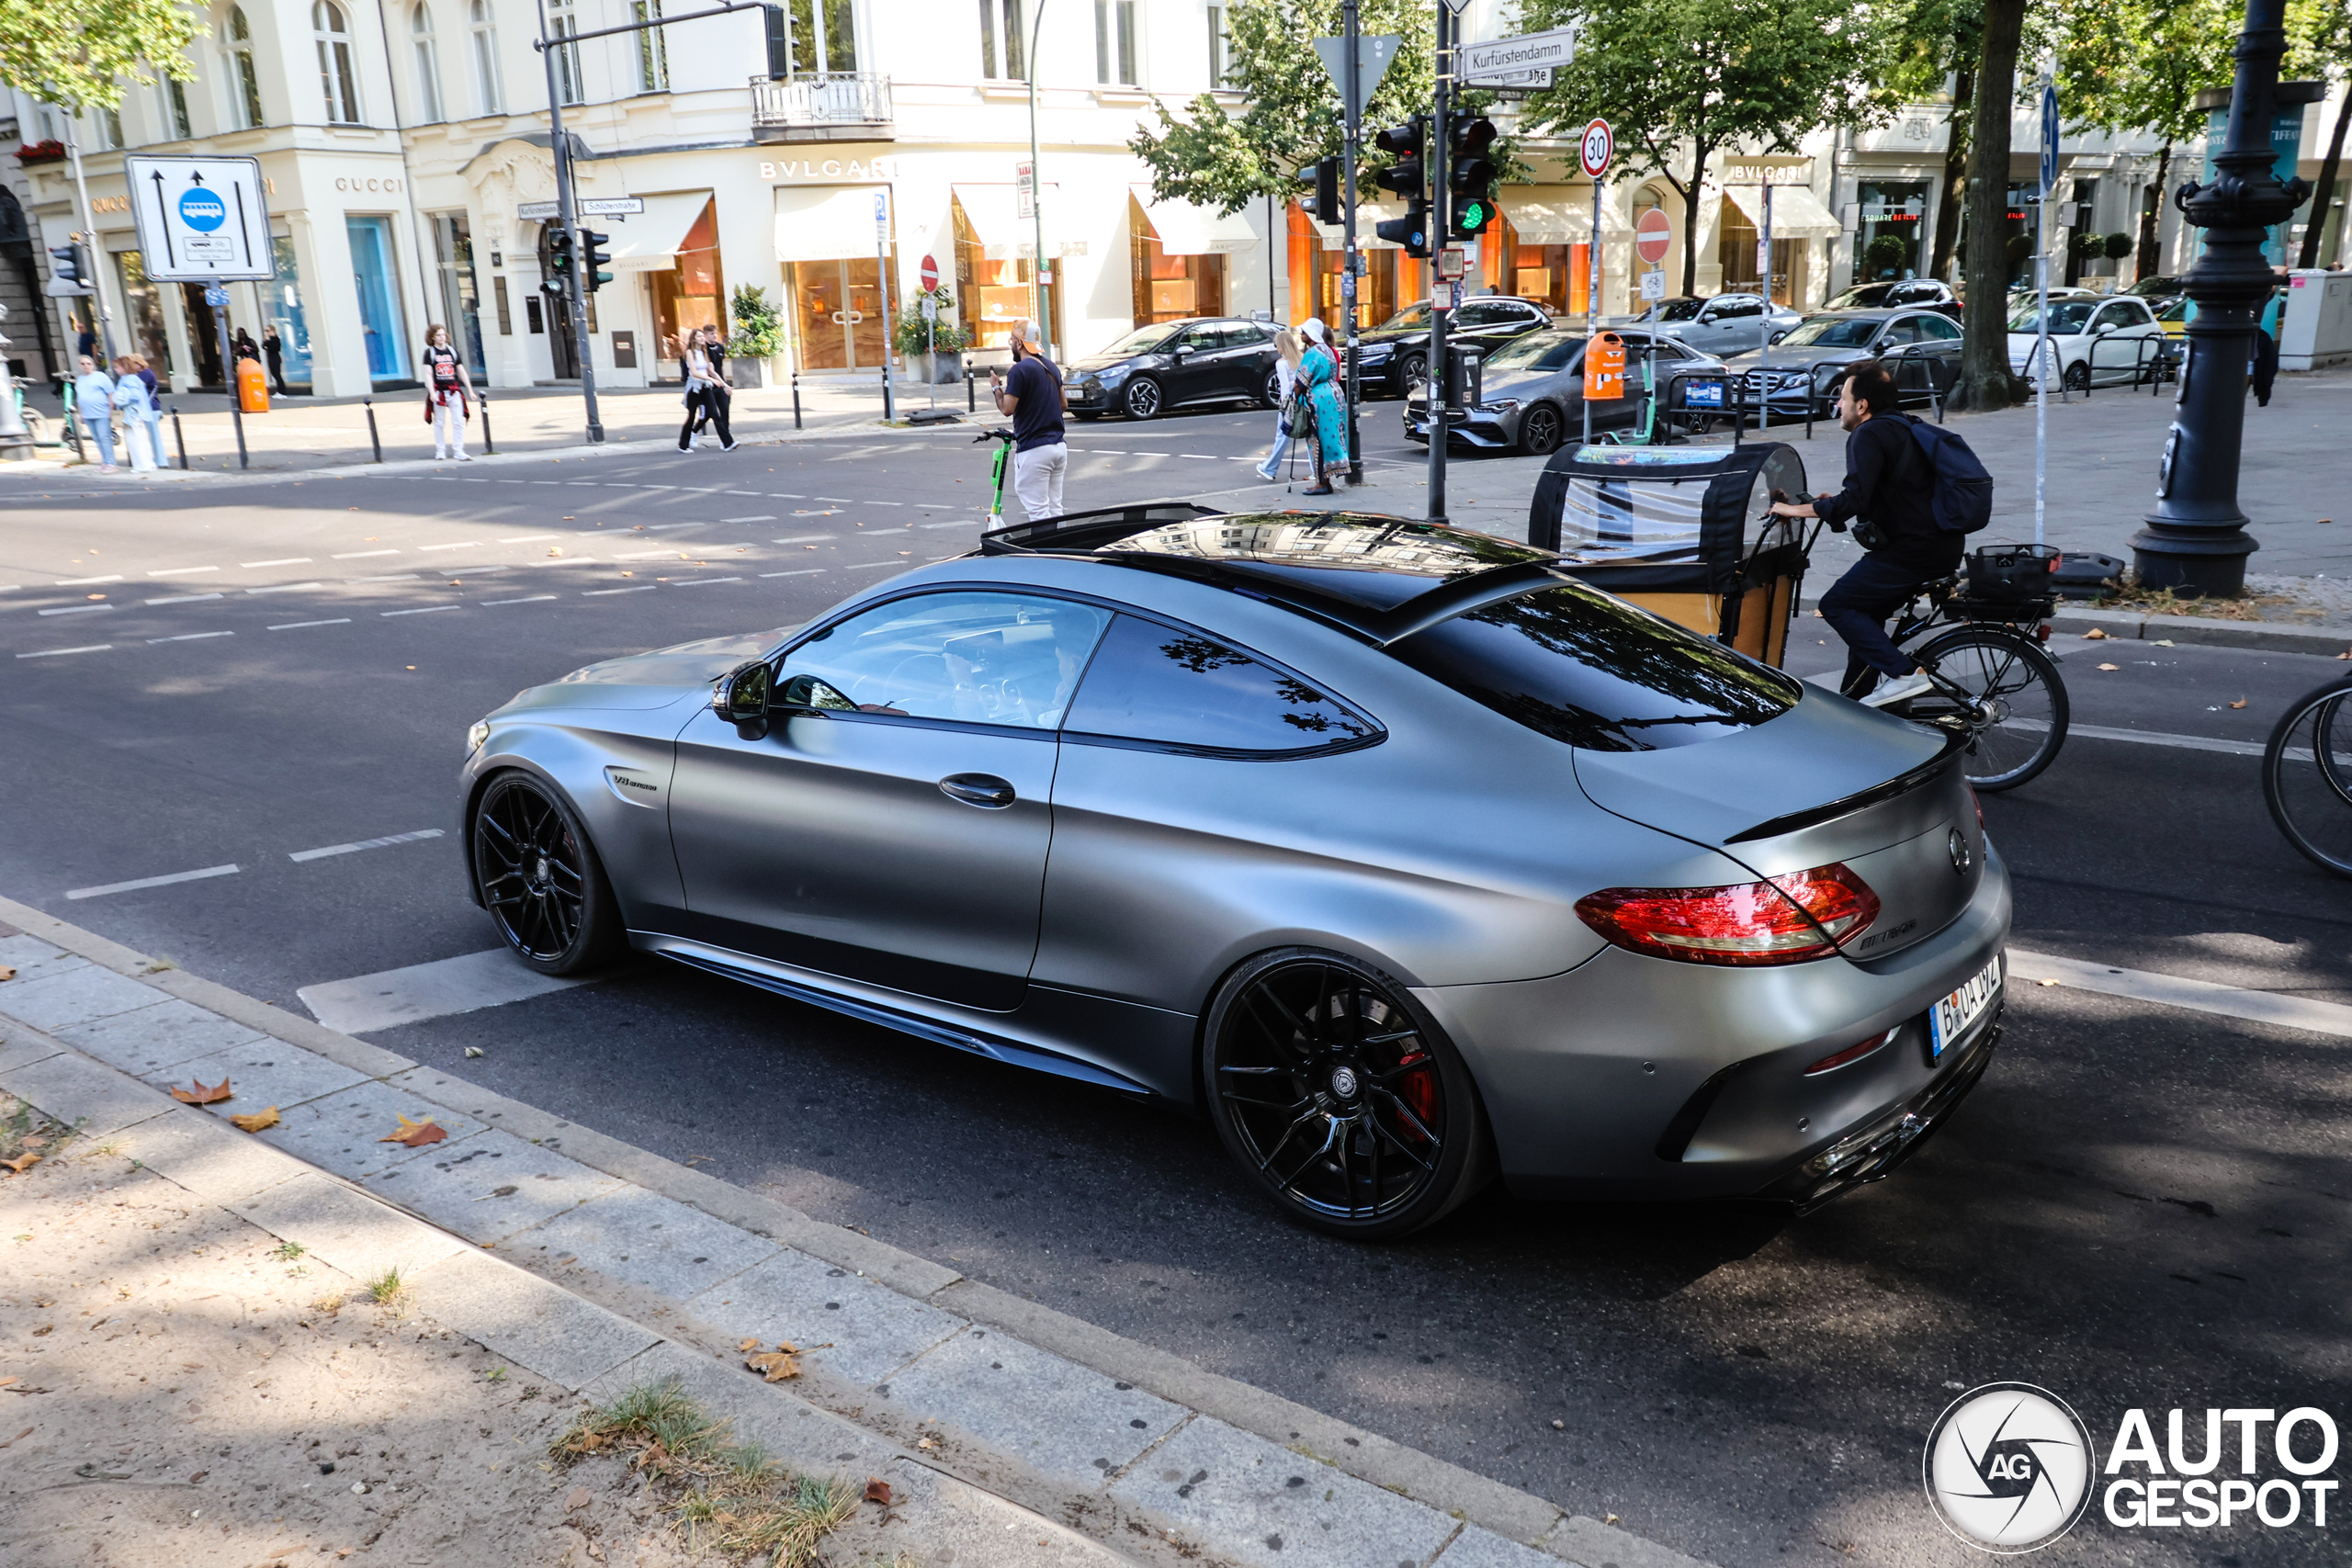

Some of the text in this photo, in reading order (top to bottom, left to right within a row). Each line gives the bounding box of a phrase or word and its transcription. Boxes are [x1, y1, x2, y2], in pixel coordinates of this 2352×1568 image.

[1473, 43, 1561, 69] Kurfürstendamm
[1588, 135, 1605, 161] 30
[759, 159, 899, 179] BVLGARI
[1734, 166, 1802, 179] BVLGARI
[335, 177, 402, 192] GUCCI
[589, 201, 636, 210] Schlüterstraße
[614, 775, 629, 785] V8
[1942, 998, 1952, 1038] B
